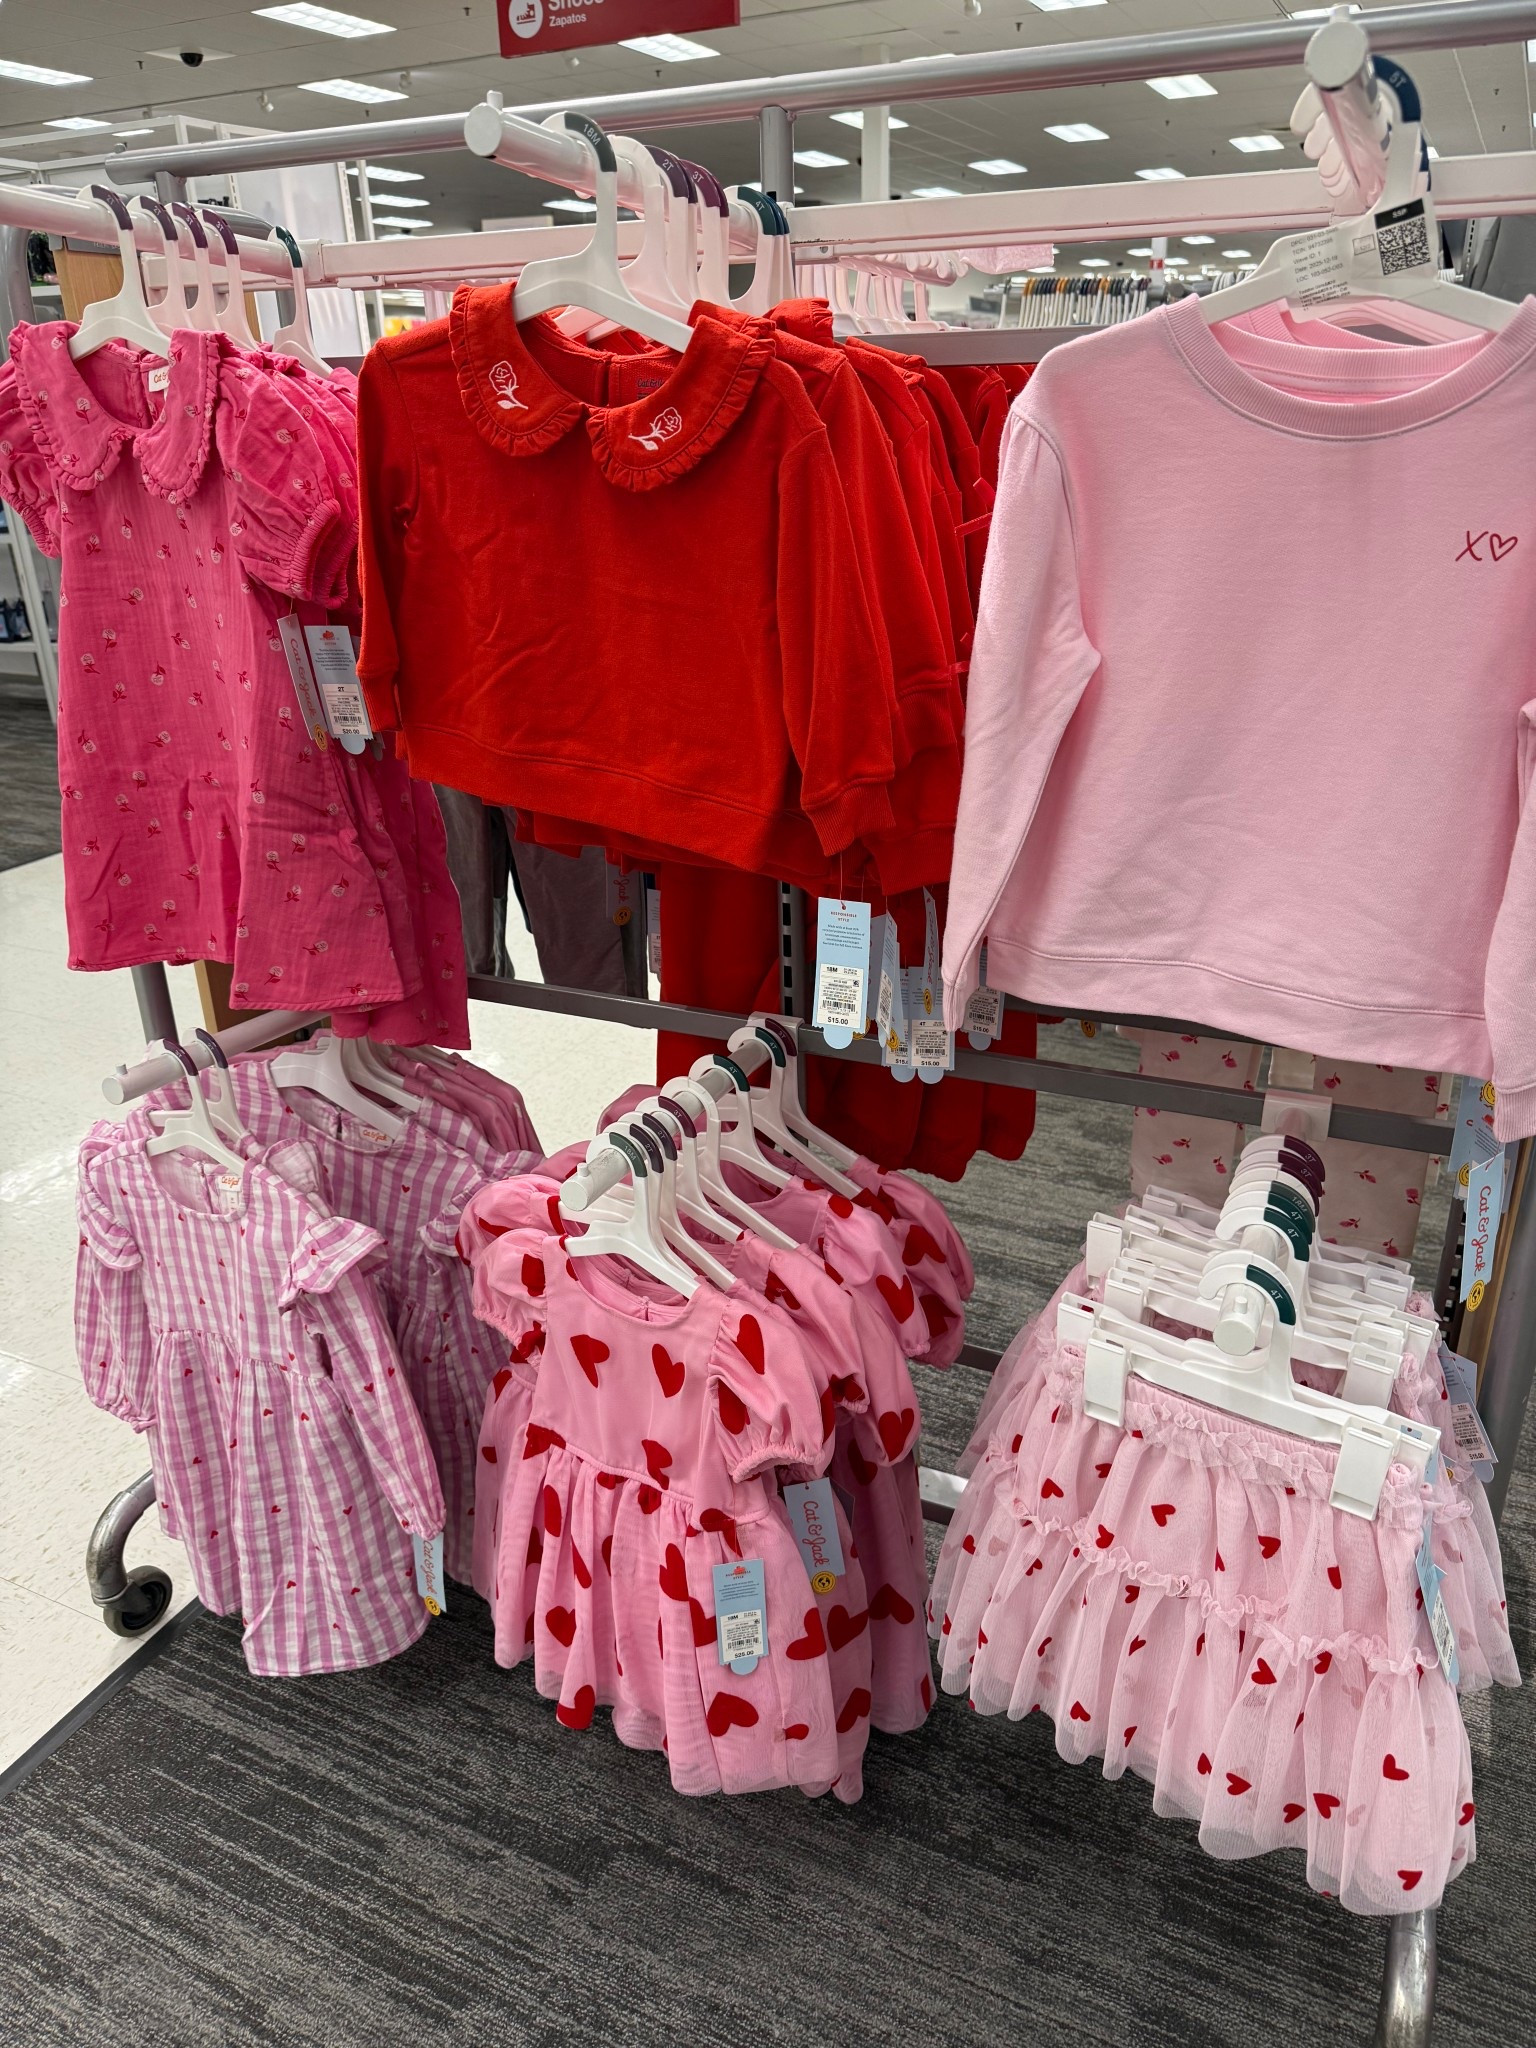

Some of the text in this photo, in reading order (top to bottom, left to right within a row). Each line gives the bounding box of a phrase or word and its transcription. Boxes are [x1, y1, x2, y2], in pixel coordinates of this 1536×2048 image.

[549, 13, 587, 27] Zapatos
[583, 123, 601, 146] 18M
[662, 159, 674, 171] 2T
[692, 171, 704, 182] 3T
[153, 206, 161, 216] 2T
[755, 201, 765, 211] 4T
[216, 221, 224, 232] 3T
[290, 638, 301, 664] Cat
[299, 682, 317, 717] Jack
[827, 1016, 849, 1025] $15.00
[972, 1025, 989, 1034] $15.00
[728, 1066, 738, 1074] 4T
[674, 1110, 683, 1118] 3T
[657, 1130, 666, 1139] 2T
[624, 1145, 637, 1161] 18M
[645, 1143, 654, 1152] 2T
[1305, 1153, 1317, 1163] 3T
[1300, 1168, 1312, 1178] 3T
[1291, 1211, 1303, 1221] 4T
[1287, 1228, 1300, 1239] 4T
[1471, 1185, 1492, 1277] Cat & Jack
[1270, 1289, 1283, 1301] 4T
[802, 1500, 829, 1568] Cat & Jack
[423, 1540, 434, 1559] Cat
[420, 1564, 438, 1594] Jack
